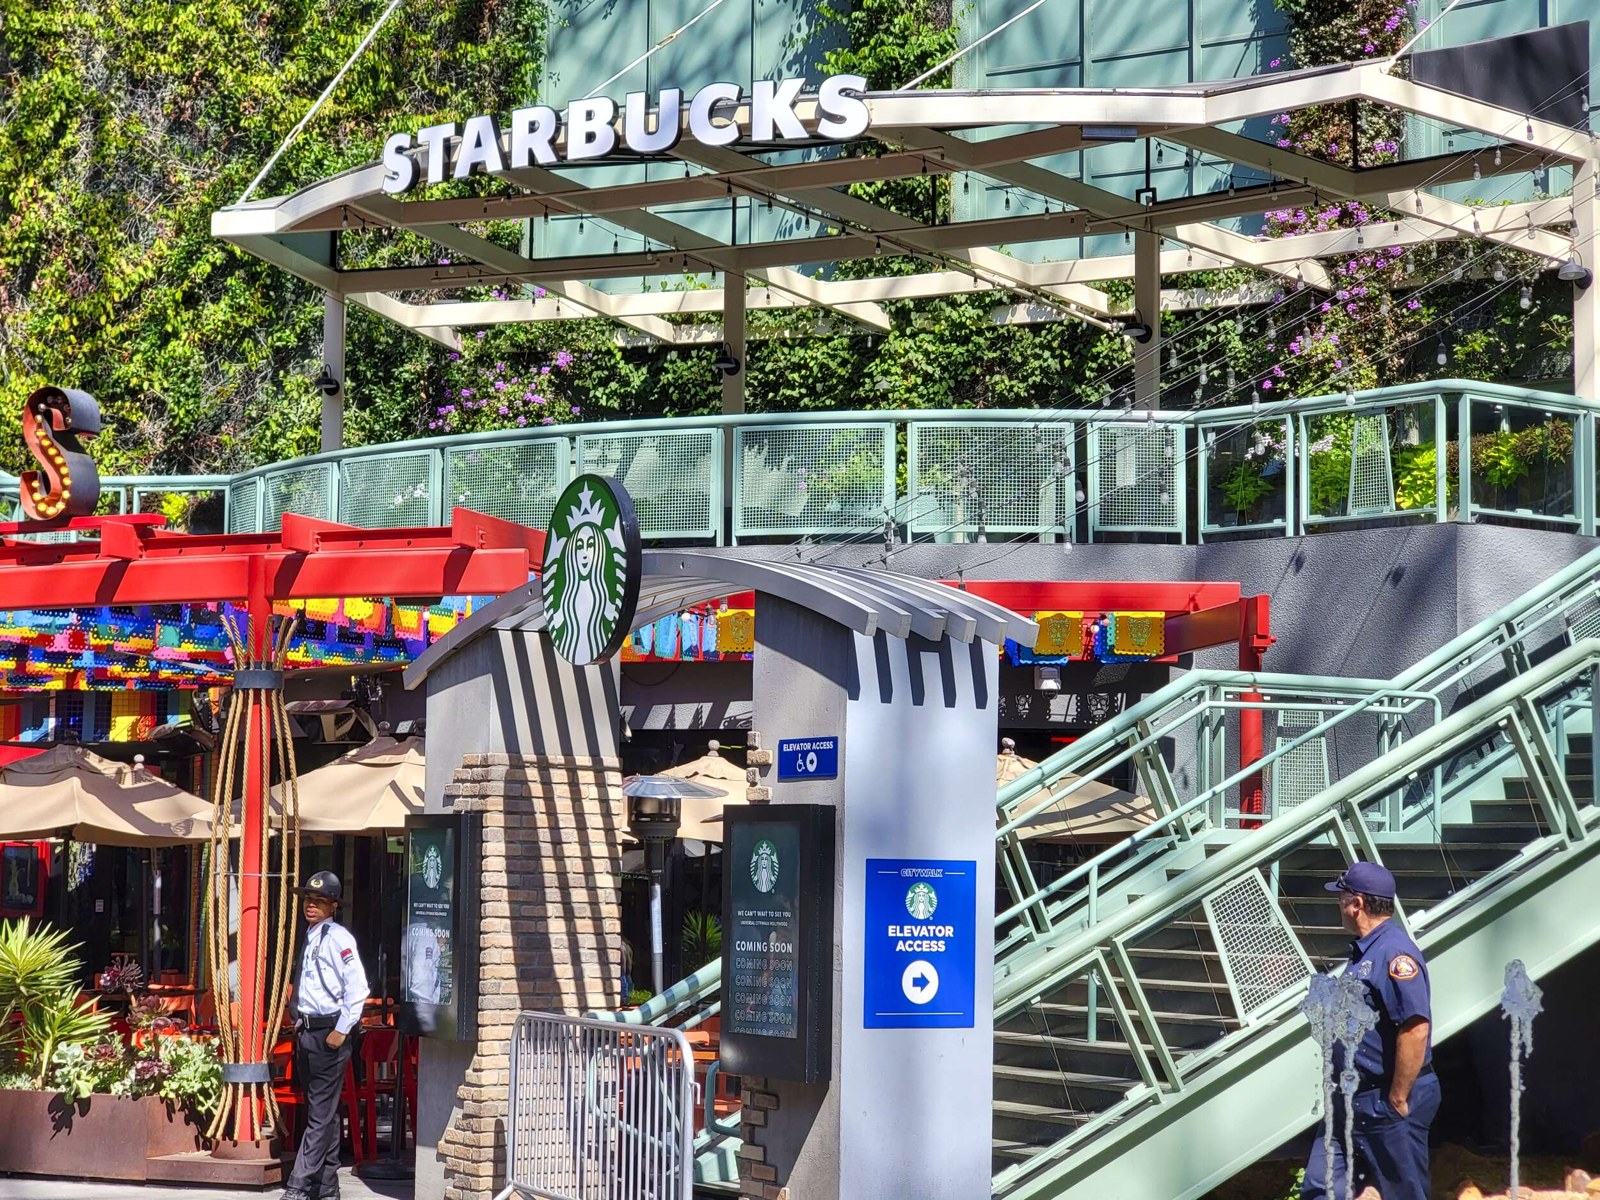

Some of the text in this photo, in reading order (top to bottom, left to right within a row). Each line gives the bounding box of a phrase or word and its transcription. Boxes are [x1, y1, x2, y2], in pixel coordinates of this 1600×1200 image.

[381, 74, 871, 196] STARBUCKS
[783, 741, 833, 751] ELEVATOR ACCESS
[900, 868, 943, 877] CITYWALK
[434, 929, 450, 938] SOON
[888, 925, 954, 937] ELEVATOR
[736, 941, 792, 953] COMING SOON
[896, 941, 946, 952] ACCESS
[736, 958, 792, 971] COMING SOON
[735, 975, 792, 988] COMING SOON
